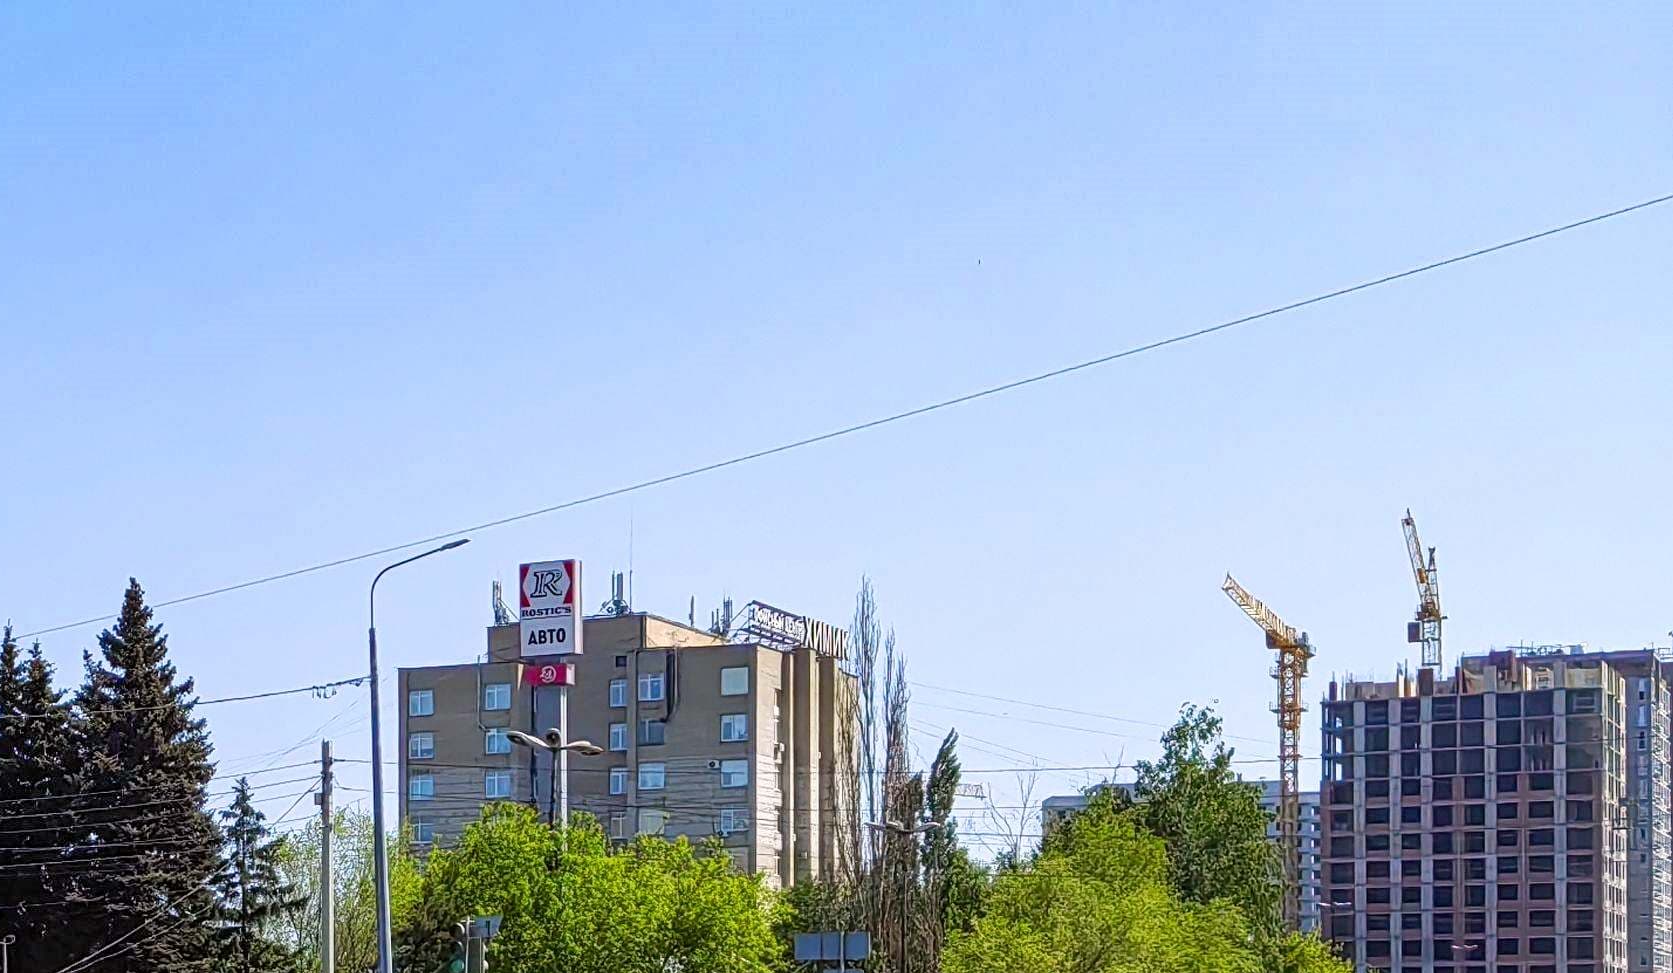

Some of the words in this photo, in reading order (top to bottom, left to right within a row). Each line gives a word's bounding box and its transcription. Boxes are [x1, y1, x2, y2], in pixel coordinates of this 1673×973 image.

[521, 606, 571, 617] ROSTIC'S
[528, 628, 566, 645] АВТО
[804, 616, 849, 660] ХИМИК
